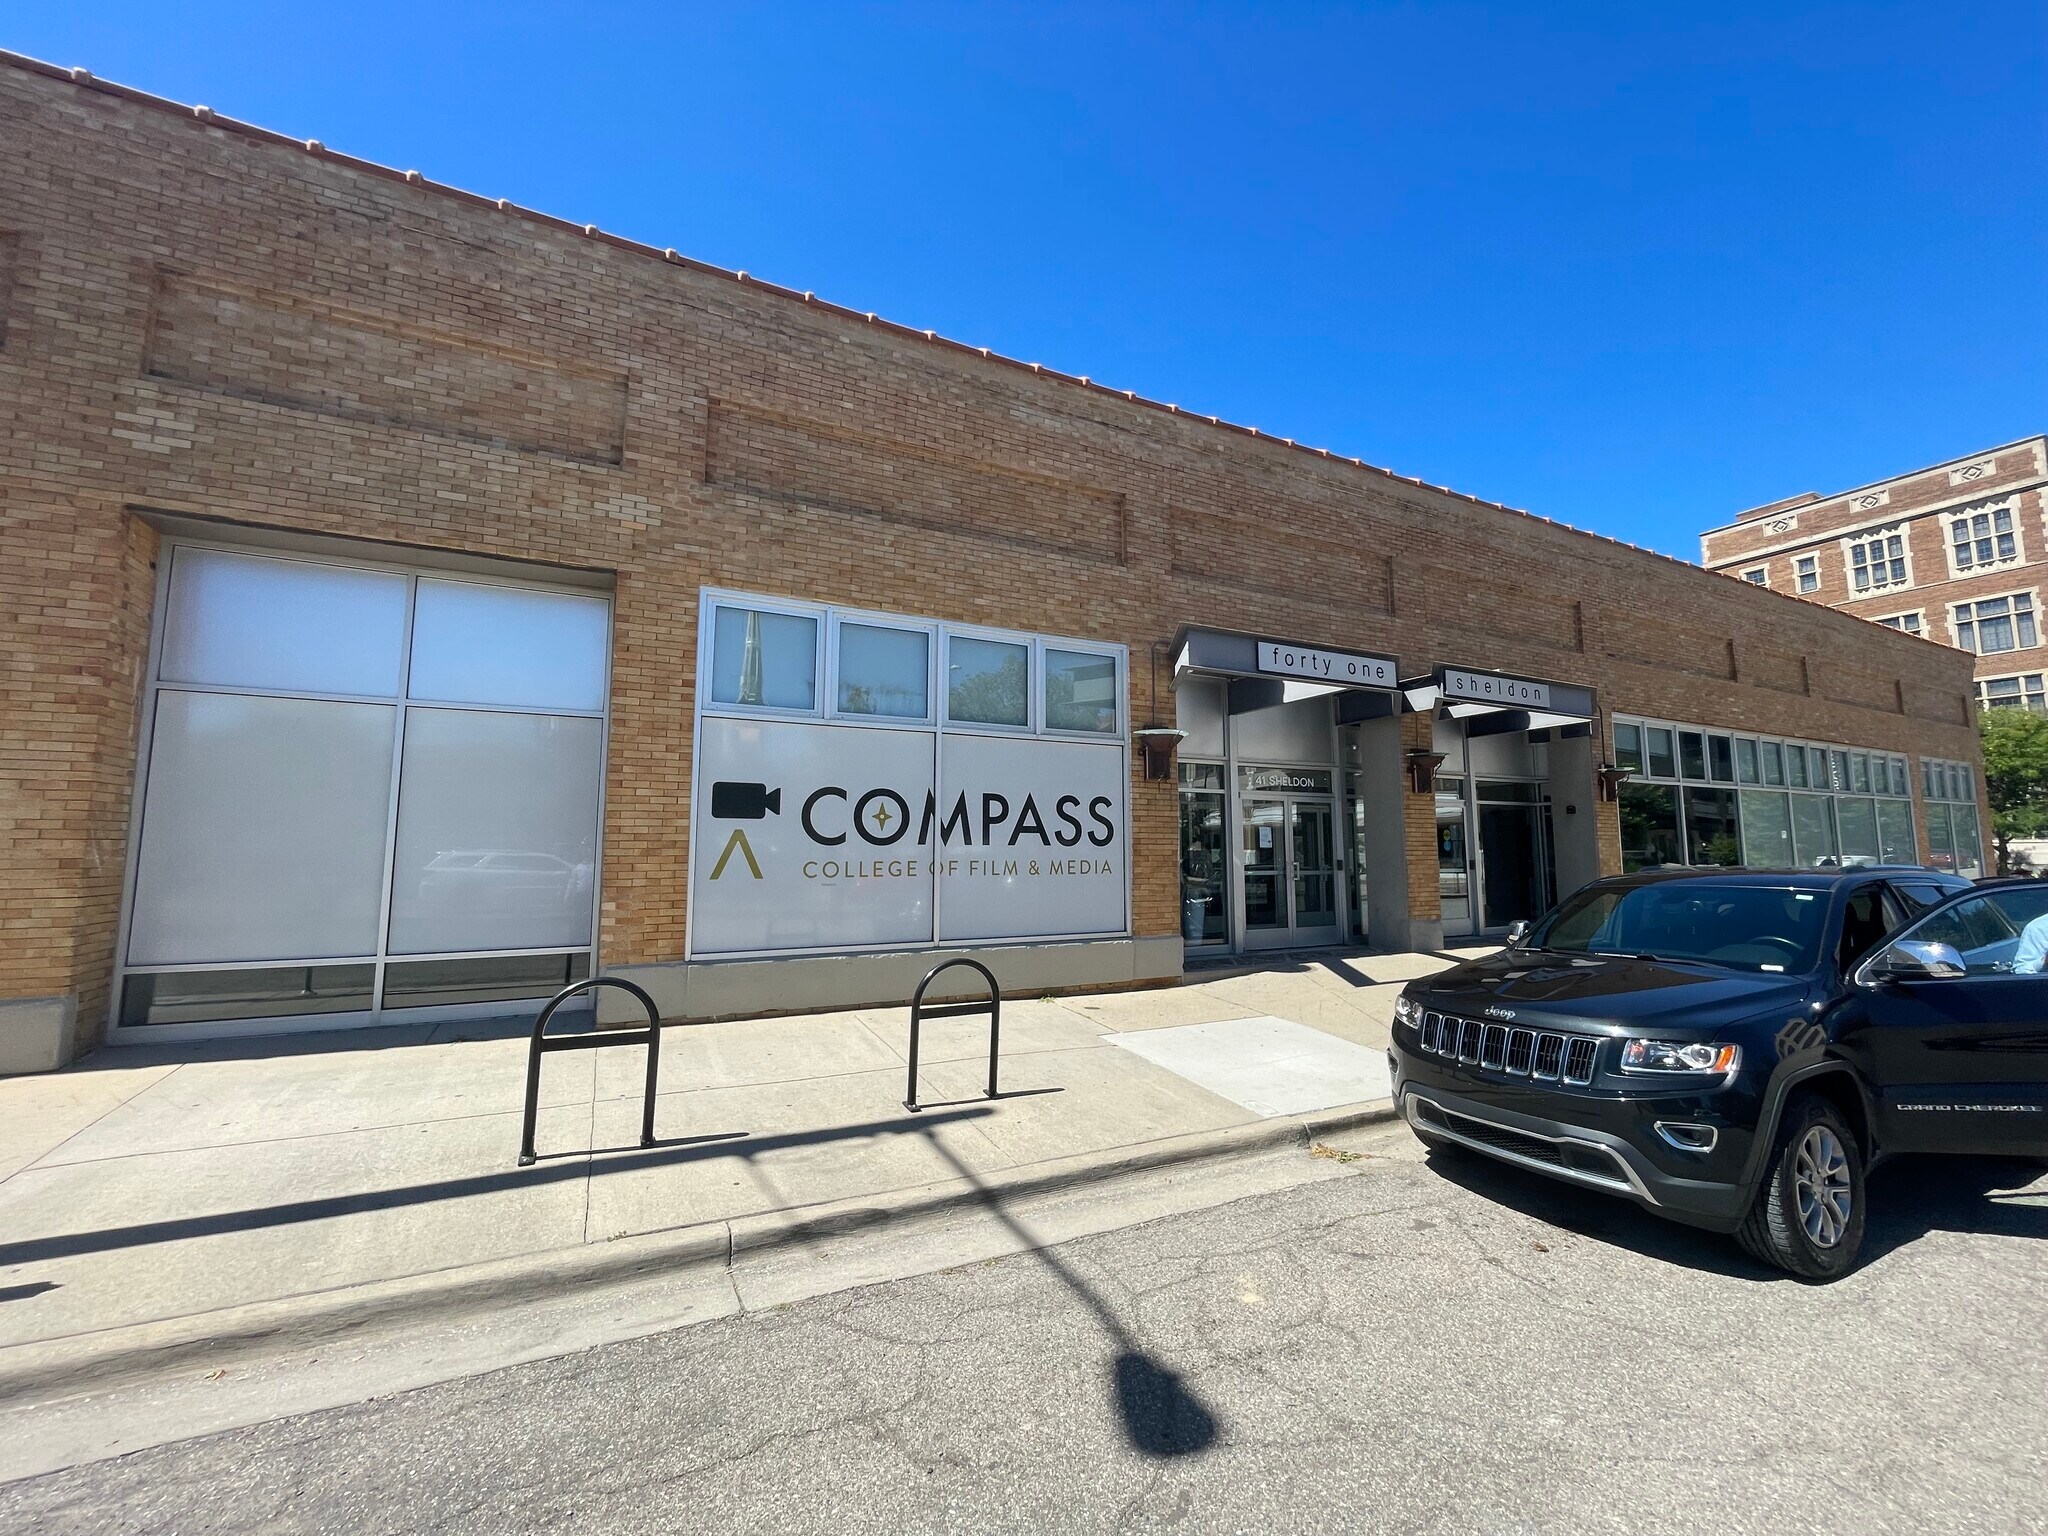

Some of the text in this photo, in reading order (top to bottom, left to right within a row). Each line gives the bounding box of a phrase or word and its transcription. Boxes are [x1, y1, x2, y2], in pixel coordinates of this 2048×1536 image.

[1272, 648, 1385, 680] forty one
[1456, 675, 1542, 701] sheldon
[1255, 775, 1315, 788] 41 SHELDON
[801, 786, 1115, 847] COMPASS
[802, 859, 1113, 879] COLLEGE OF FILM & MEDIA
[1484, 1005, 1517, 1021] Jeep
